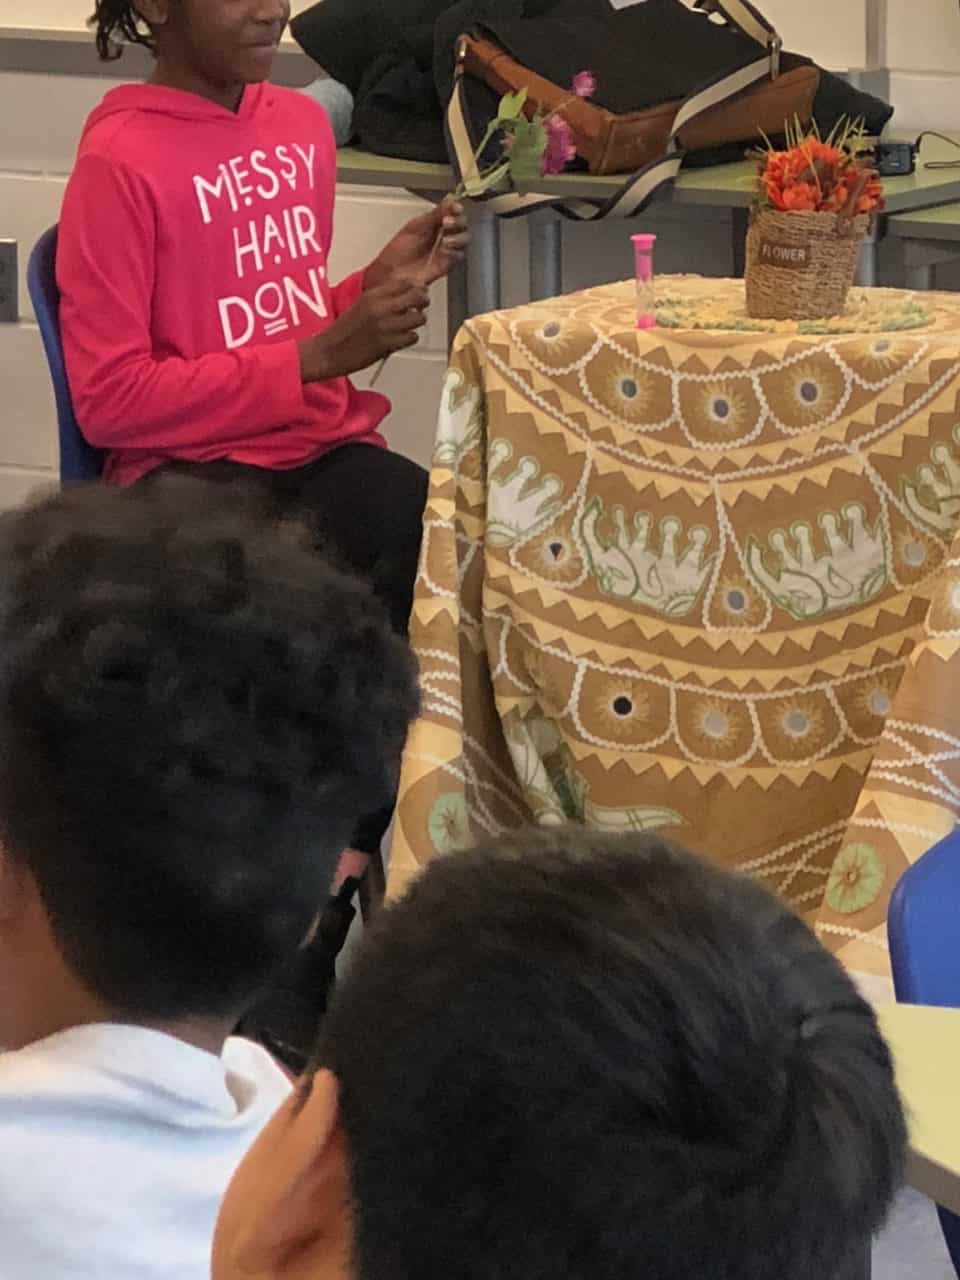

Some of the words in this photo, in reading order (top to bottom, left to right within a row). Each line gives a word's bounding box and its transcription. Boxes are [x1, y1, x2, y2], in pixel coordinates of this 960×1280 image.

[193, 143, 315, 224] MESSY
[233, 205, 322, 278] HAIR
[762, 243, 806, 261] FLOWER
